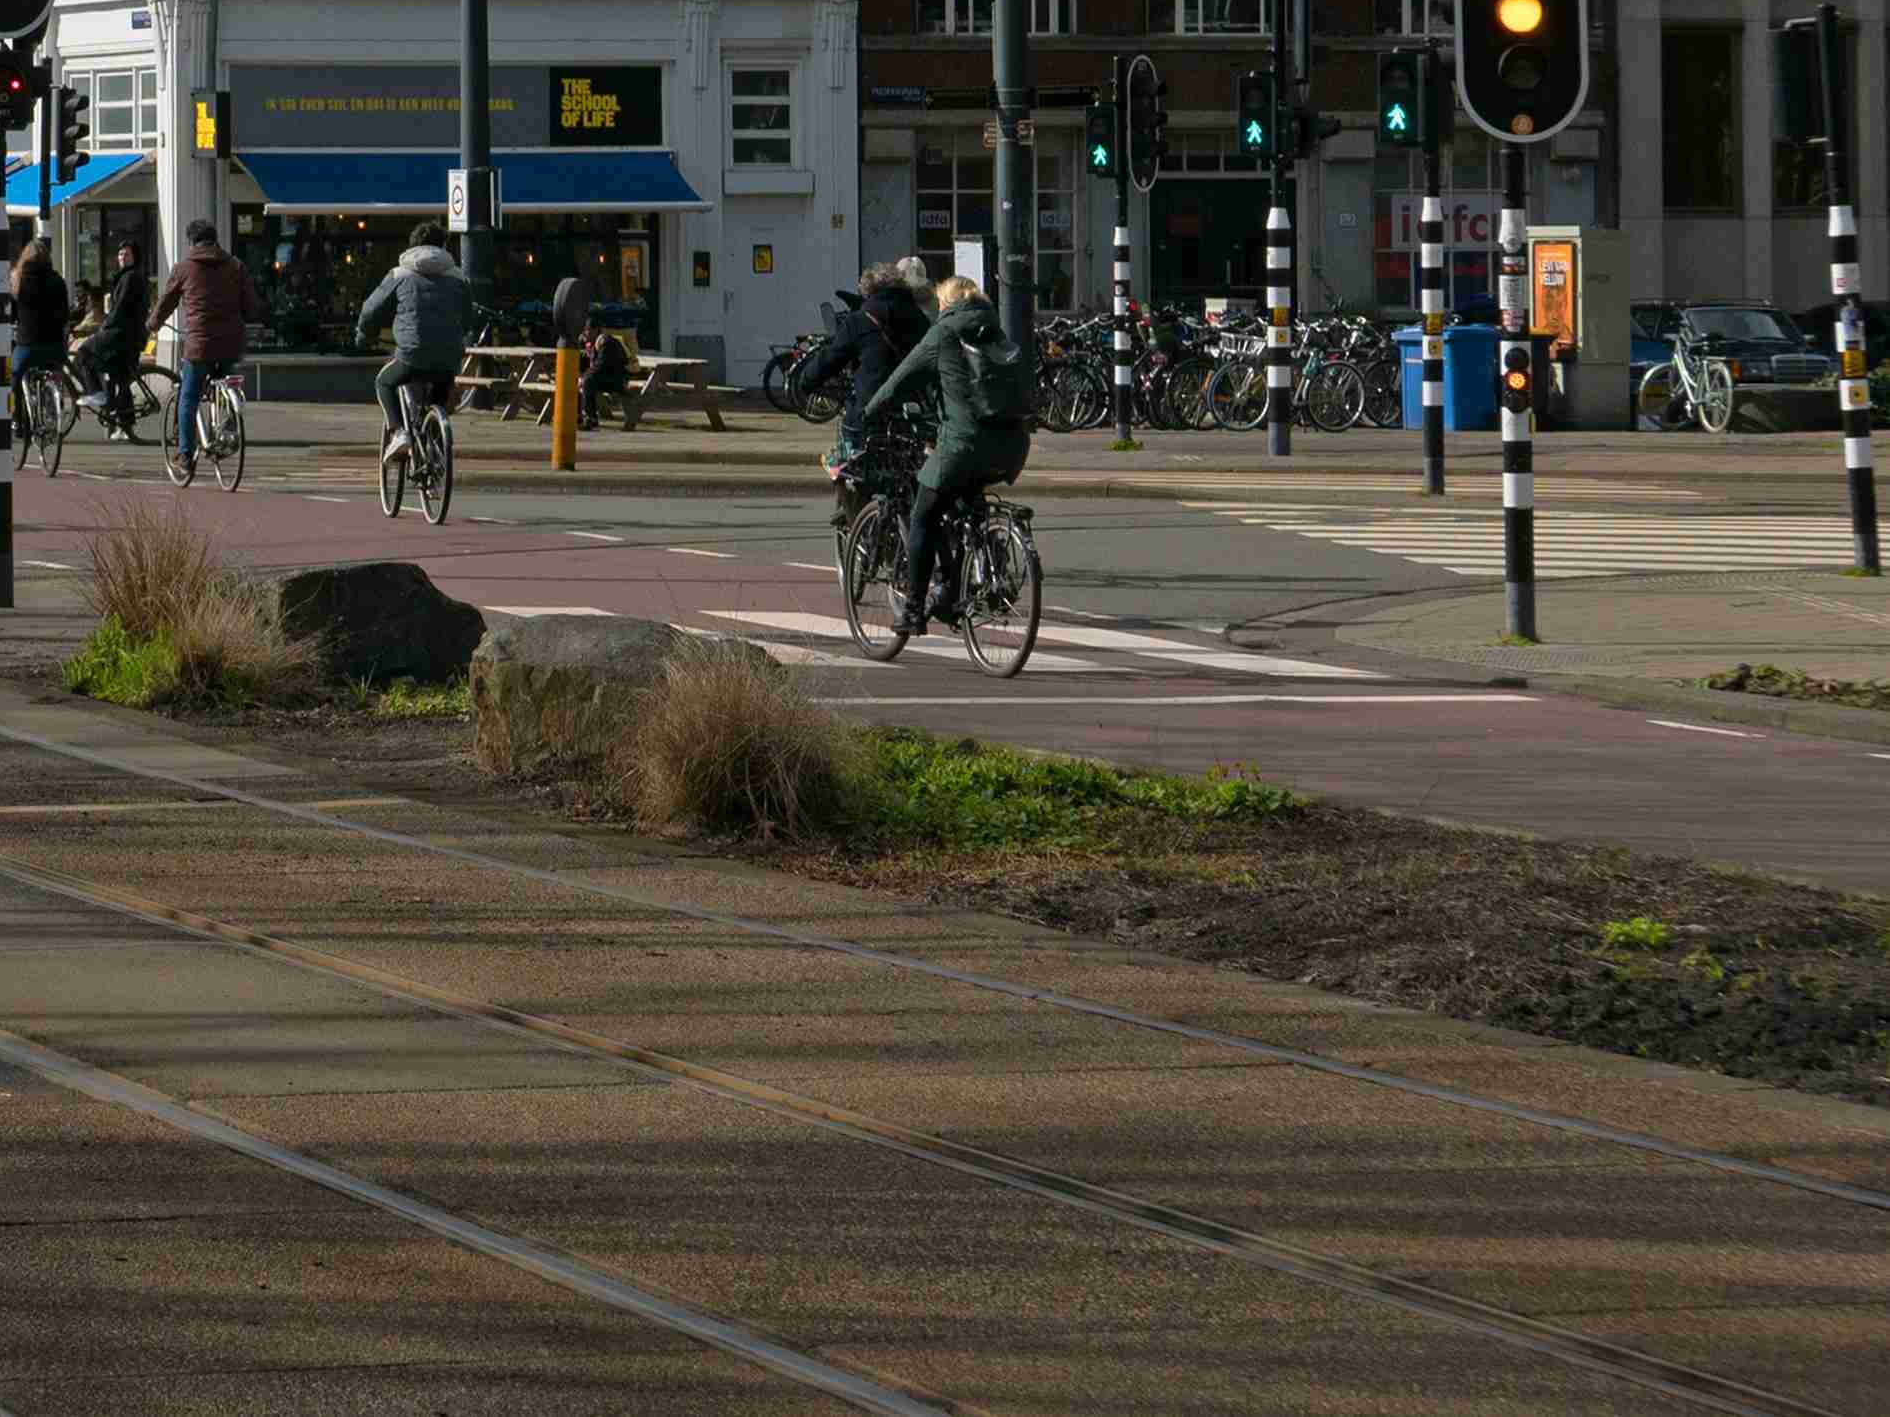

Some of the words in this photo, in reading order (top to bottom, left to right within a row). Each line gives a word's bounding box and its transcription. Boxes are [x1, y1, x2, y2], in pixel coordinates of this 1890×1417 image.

[560, 78, 592, 95] THE
[560, 94, 622, 111] SCHOOL
[560, 110, 581, 128] OF
[583, 110, 616, 128] LIFE
